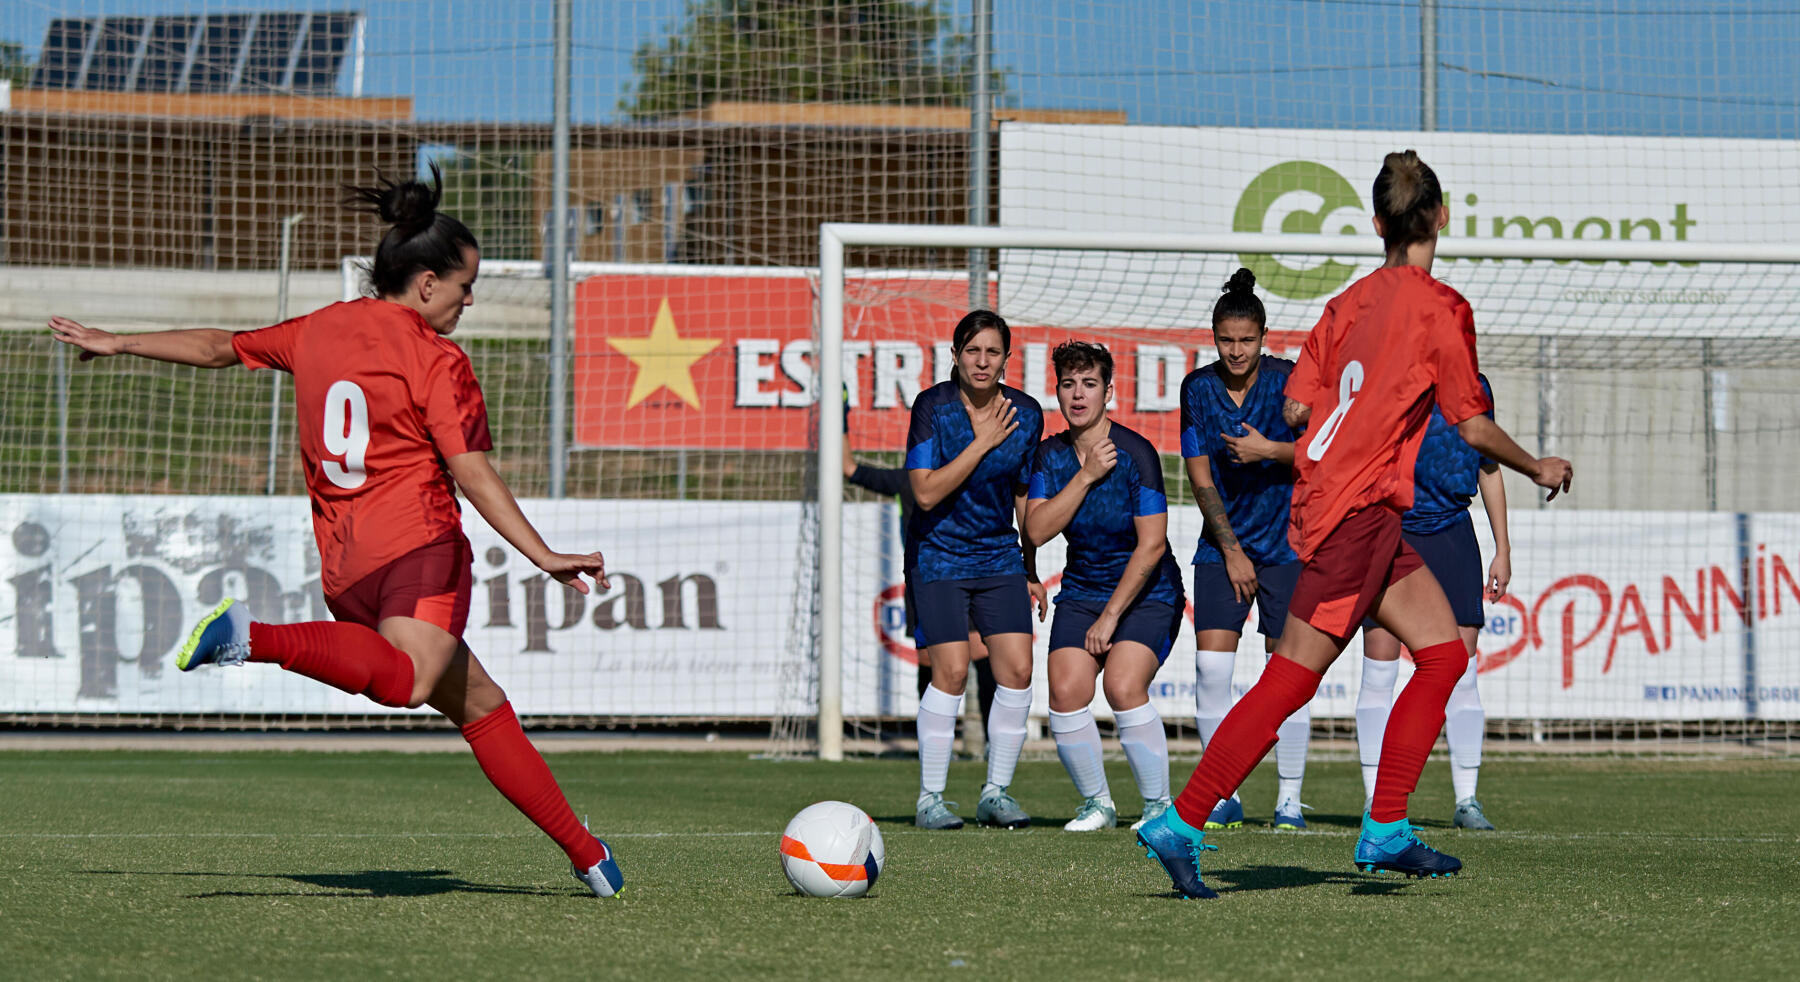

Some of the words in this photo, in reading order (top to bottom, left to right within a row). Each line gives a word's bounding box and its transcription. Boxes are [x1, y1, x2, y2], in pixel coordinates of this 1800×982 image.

[735, 338, 1119, 412] ESTRL
[321, 380, 370, 489] 9
[7, 520, 328, 699] ipa
[471, 546, 726, 653] ipan
